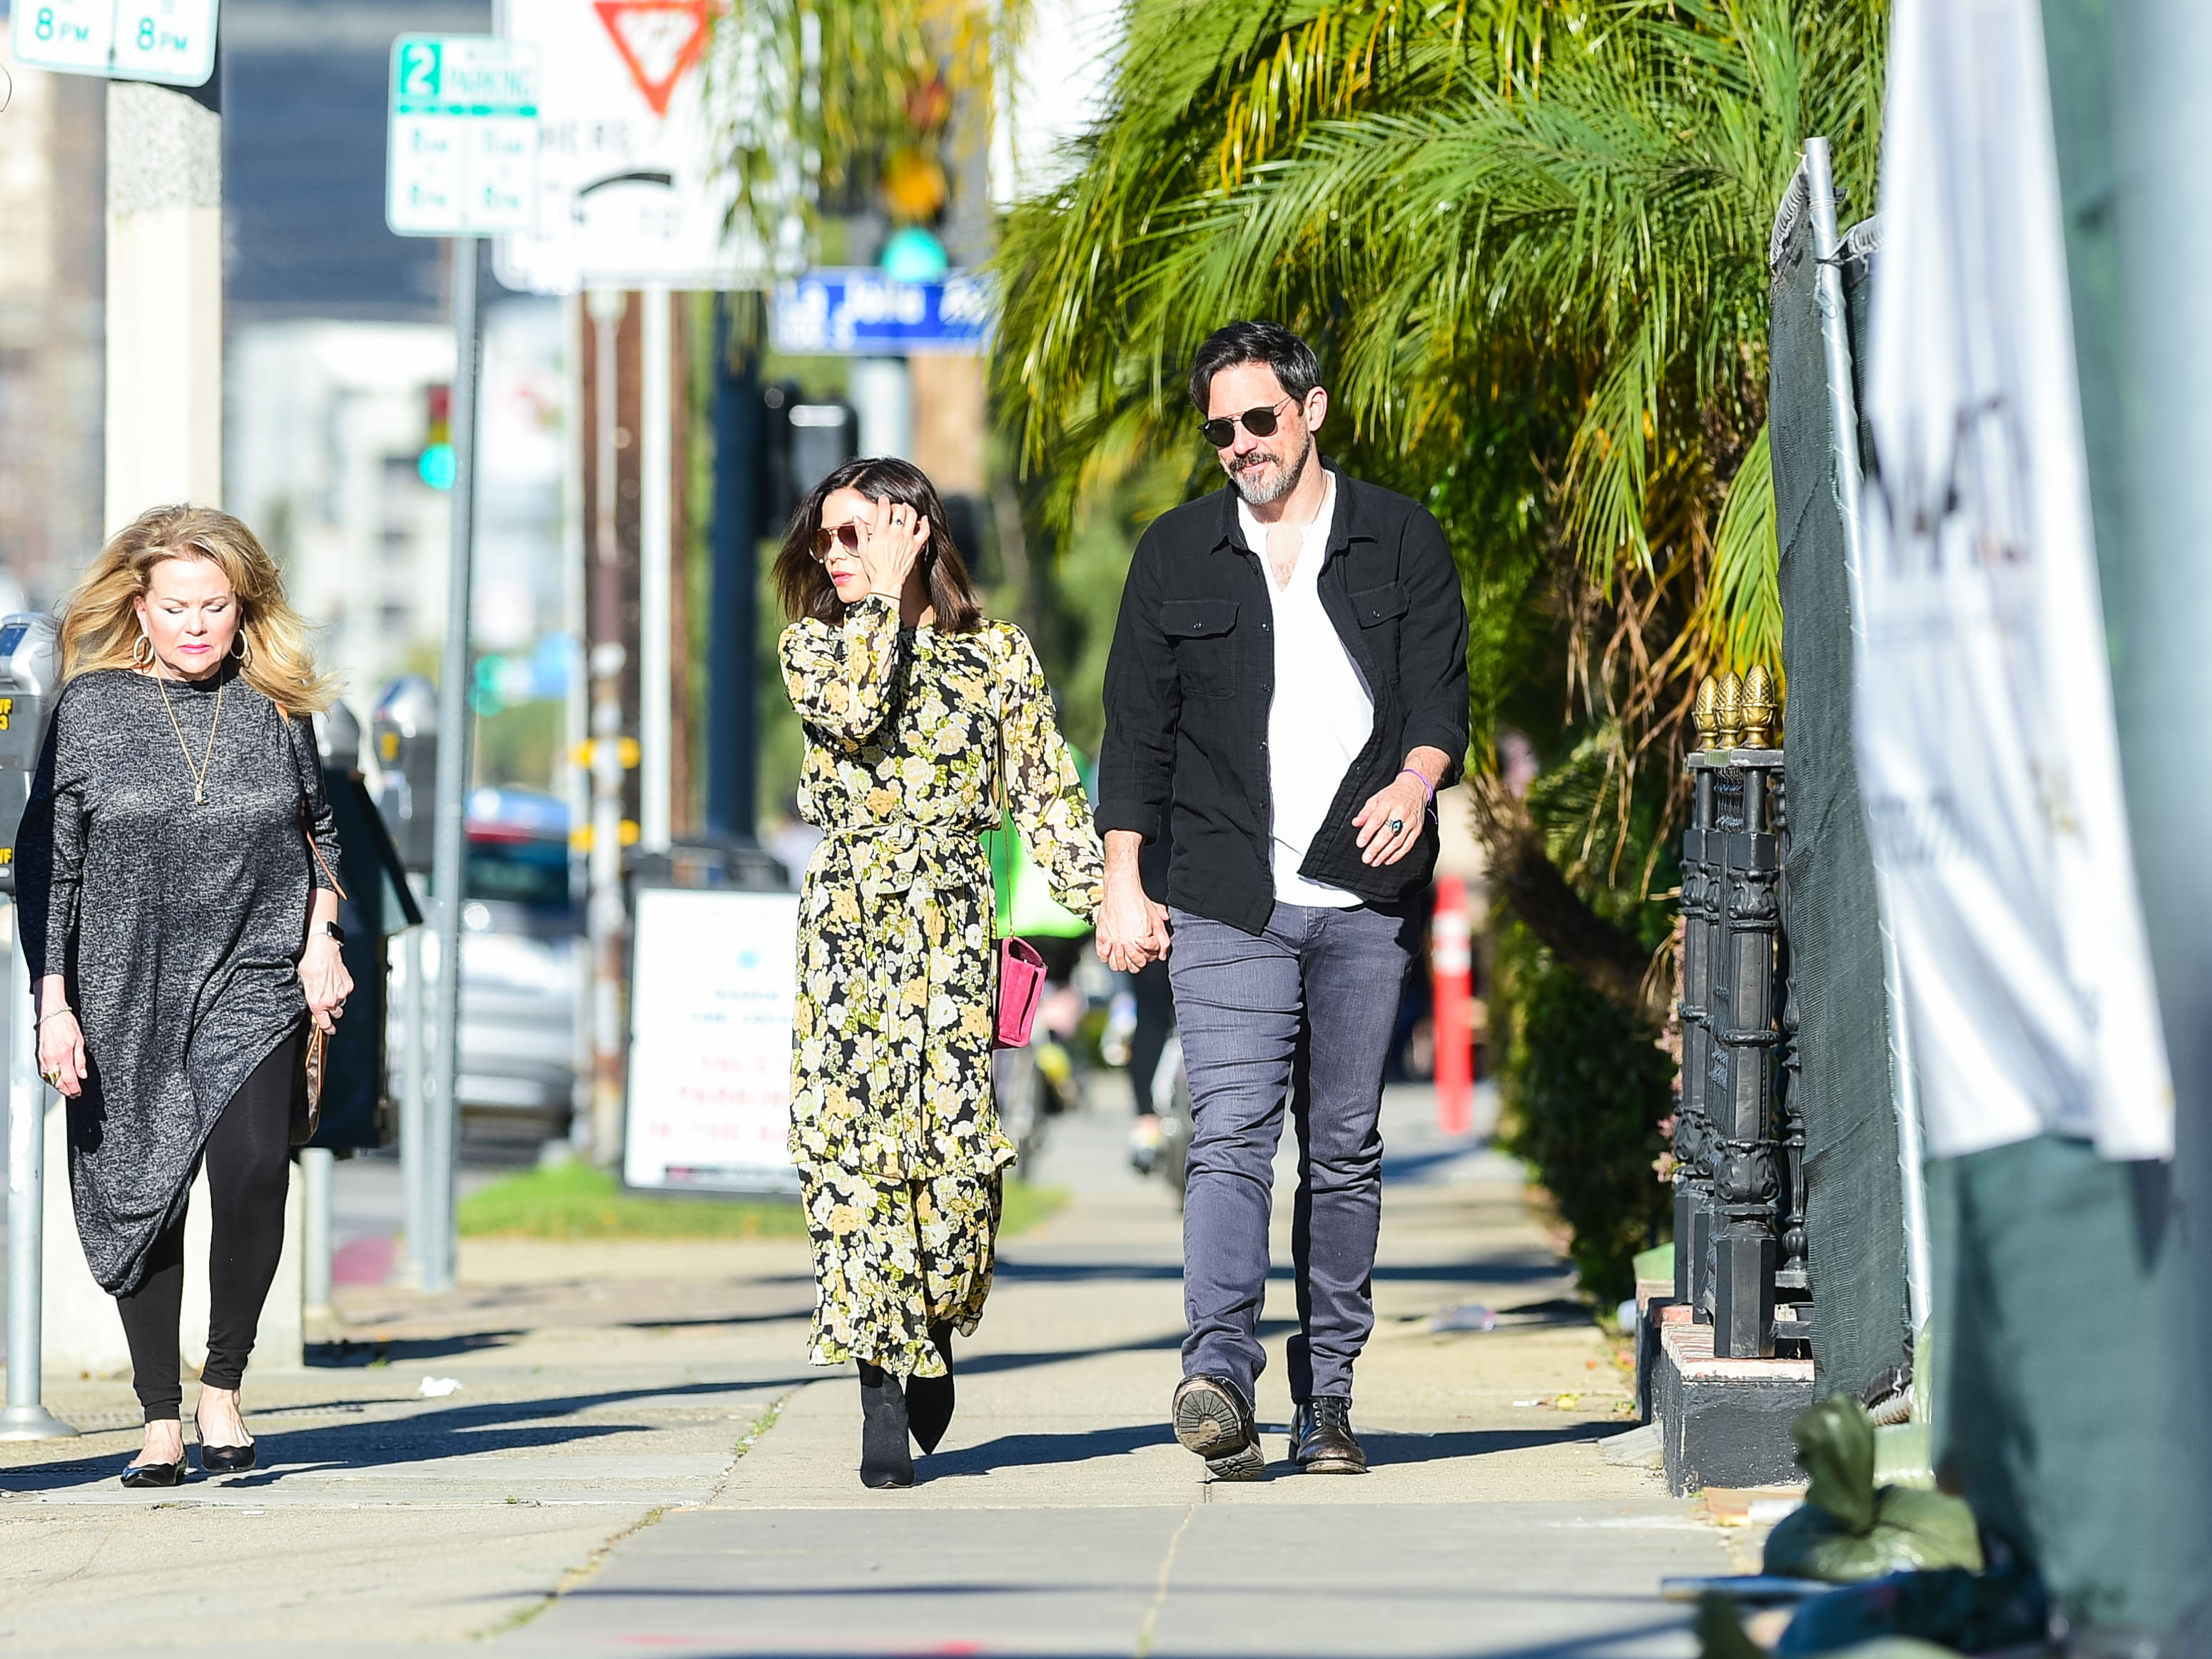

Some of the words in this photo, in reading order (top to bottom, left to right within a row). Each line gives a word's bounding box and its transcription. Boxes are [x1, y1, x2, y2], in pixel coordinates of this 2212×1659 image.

[36, 7, 54, 41] 8
[137, 17, 155, 50] 8
[406, 45, 436, 96] 2
